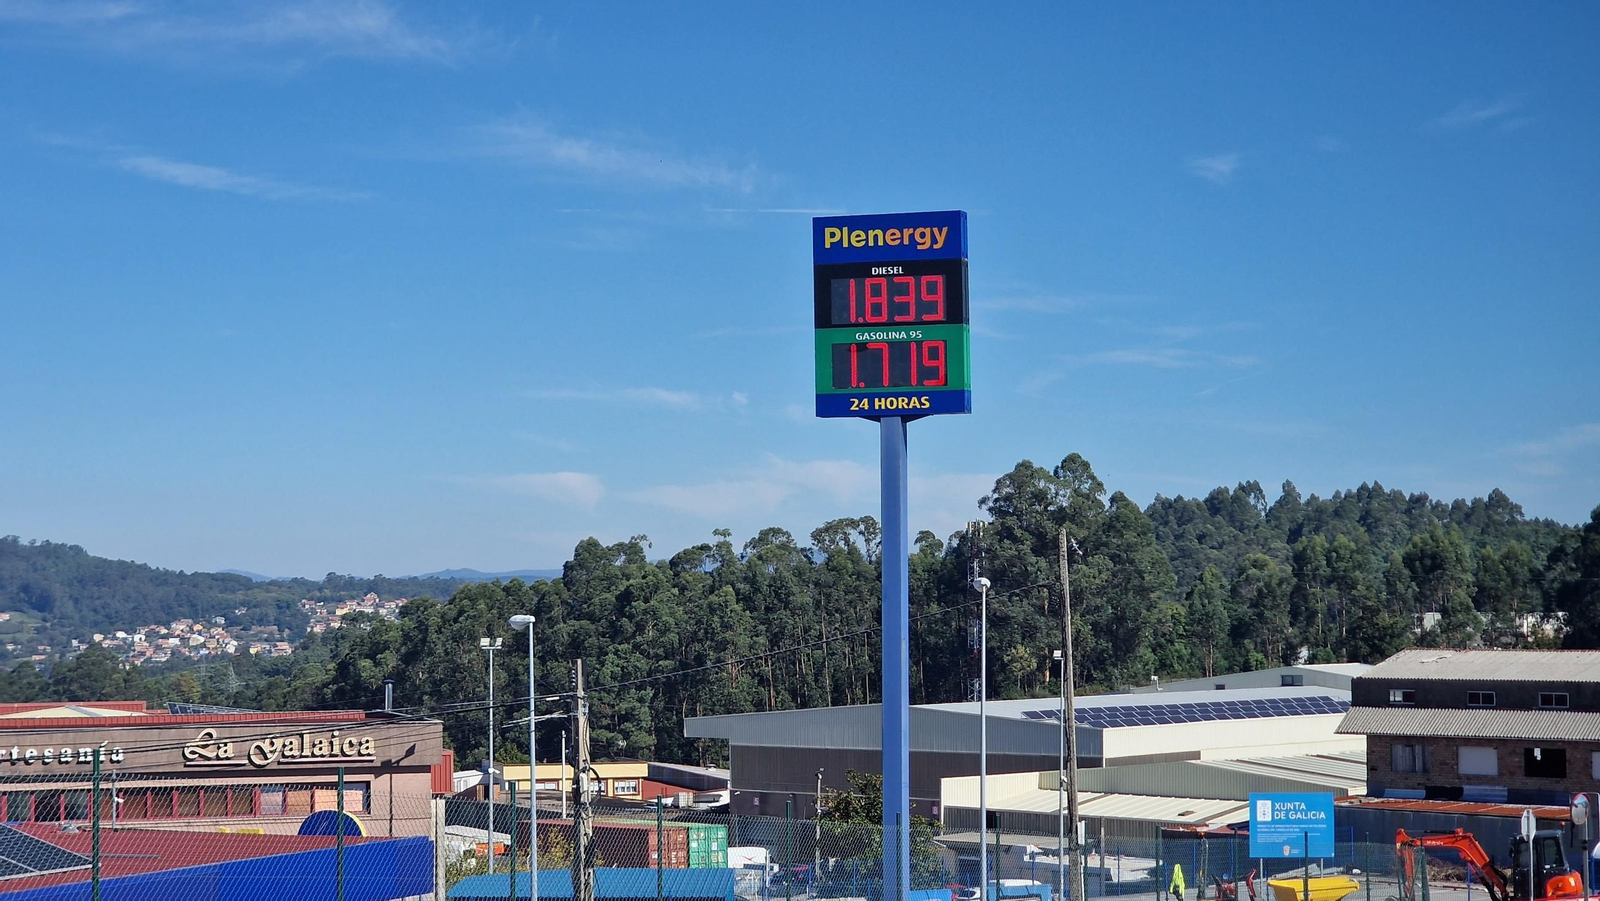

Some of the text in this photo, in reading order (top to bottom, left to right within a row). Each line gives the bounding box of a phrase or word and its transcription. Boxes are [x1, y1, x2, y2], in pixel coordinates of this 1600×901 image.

[824, 226, 948, 250] Plenergy
[872, 266, 904, 275] DIESEL
[849, 275, 944, 323] 1.839
[855, 330, 923, 340] GASOLINA 95
[850, 340, 946, 388] 1.719
[849, 396, 930, 411] 24 HORAS
[184, 728, 376, 766] La Galaica
[1274, 802, 1307, 811] XUNTA
[1274, 811, 1326, 820] DE GALICIA
